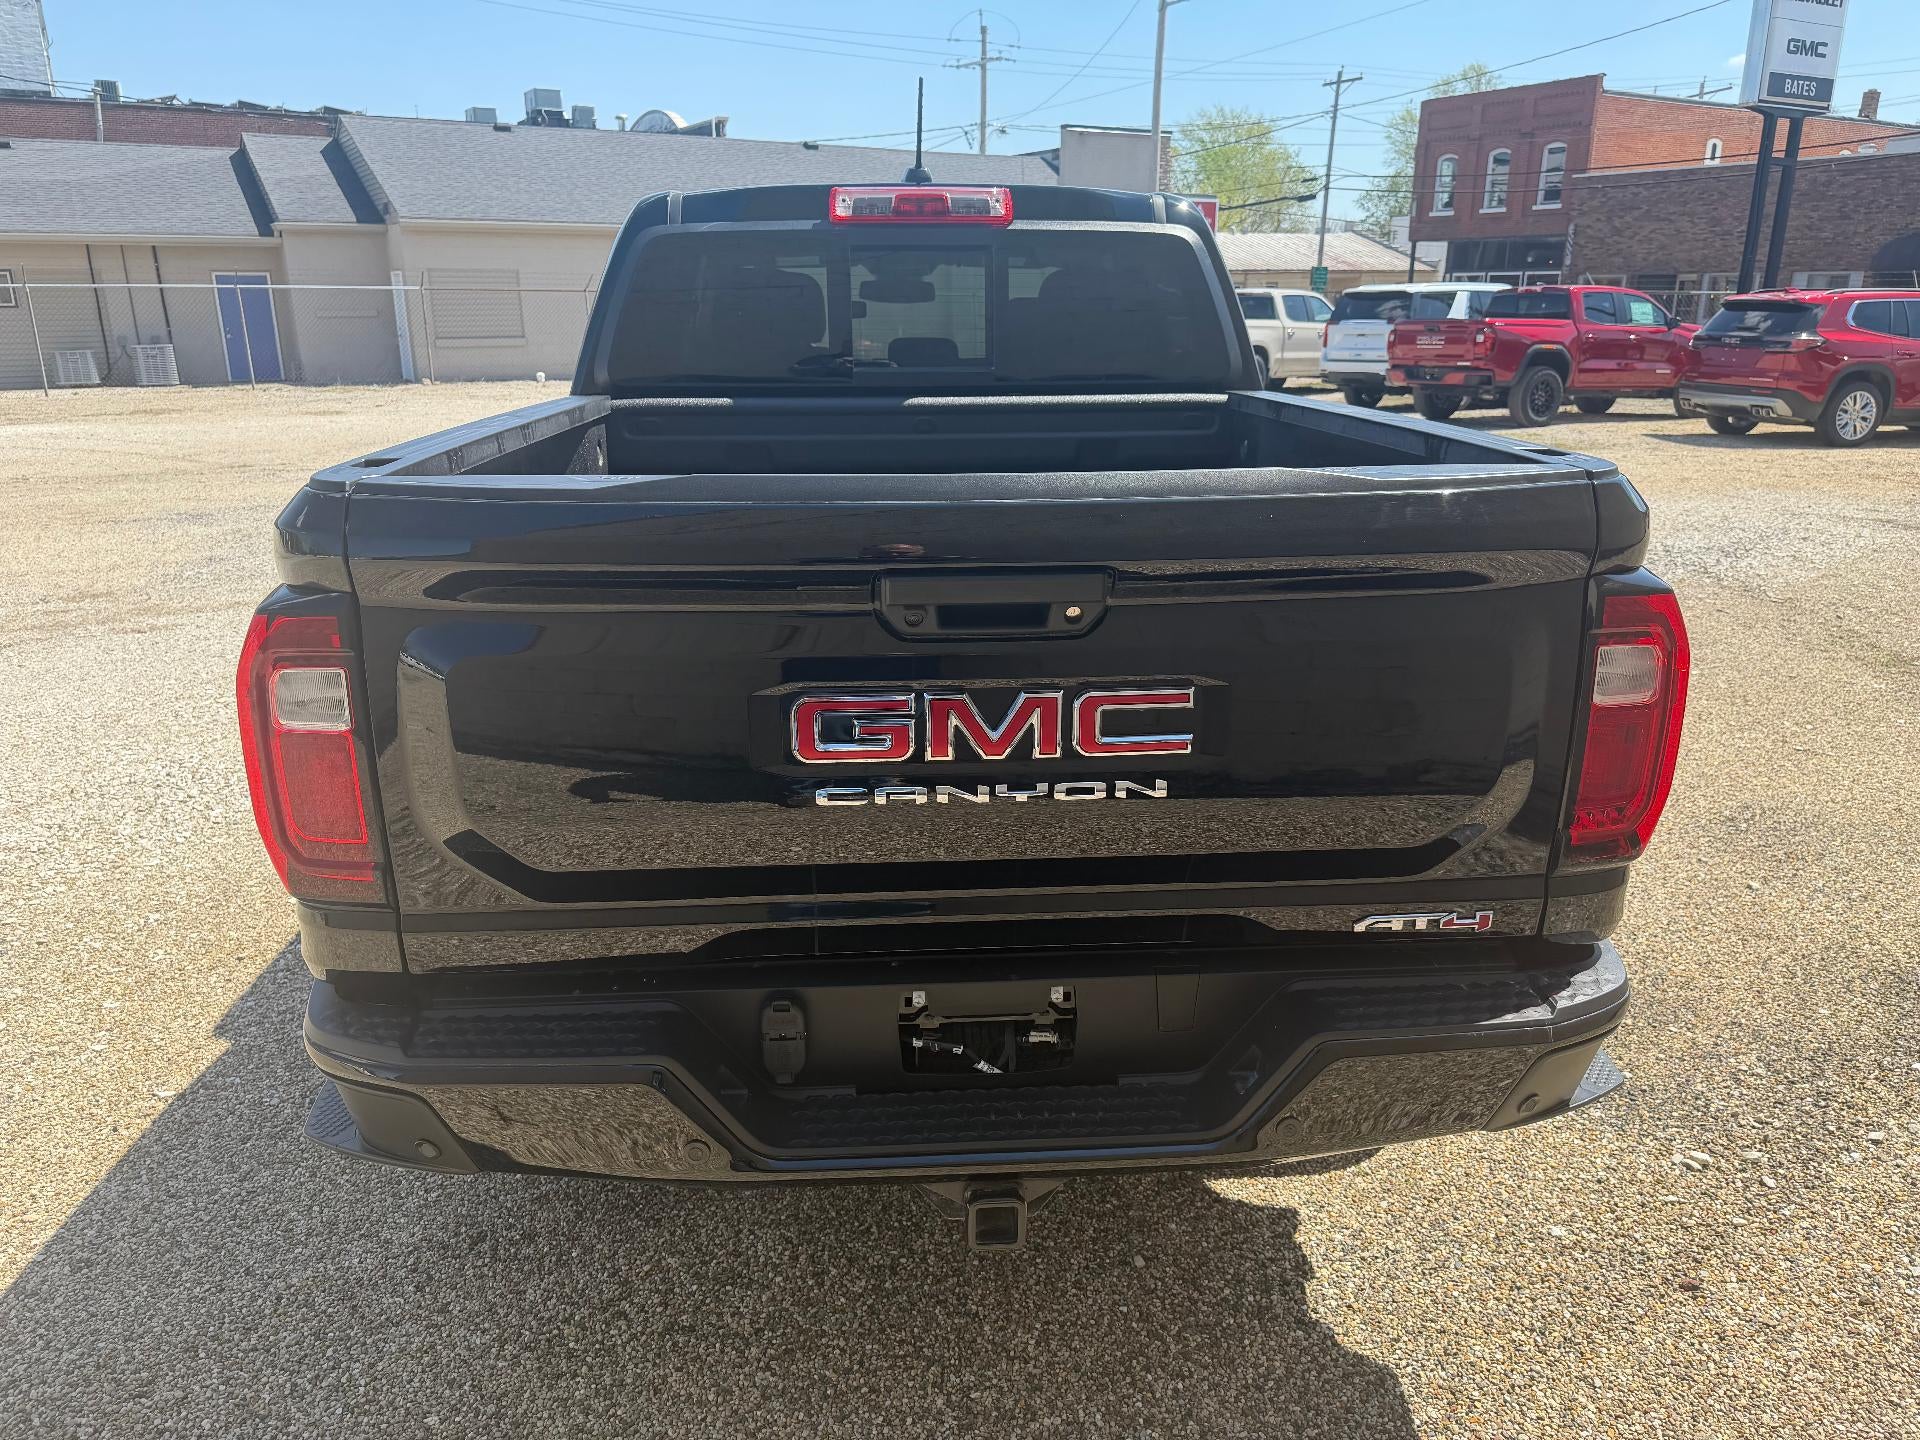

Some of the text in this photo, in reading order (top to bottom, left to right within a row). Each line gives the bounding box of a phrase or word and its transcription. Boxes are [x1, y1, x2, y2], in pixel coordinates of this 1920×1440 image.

[1787, 38, 1828, 58] GMC
[1784, 78, 1817, 97] BATES
[790, 687, 1195, 764] GMC
[815, 779, 1168, 806] CANYON
[1353, 911, 1494, 933] AT4
